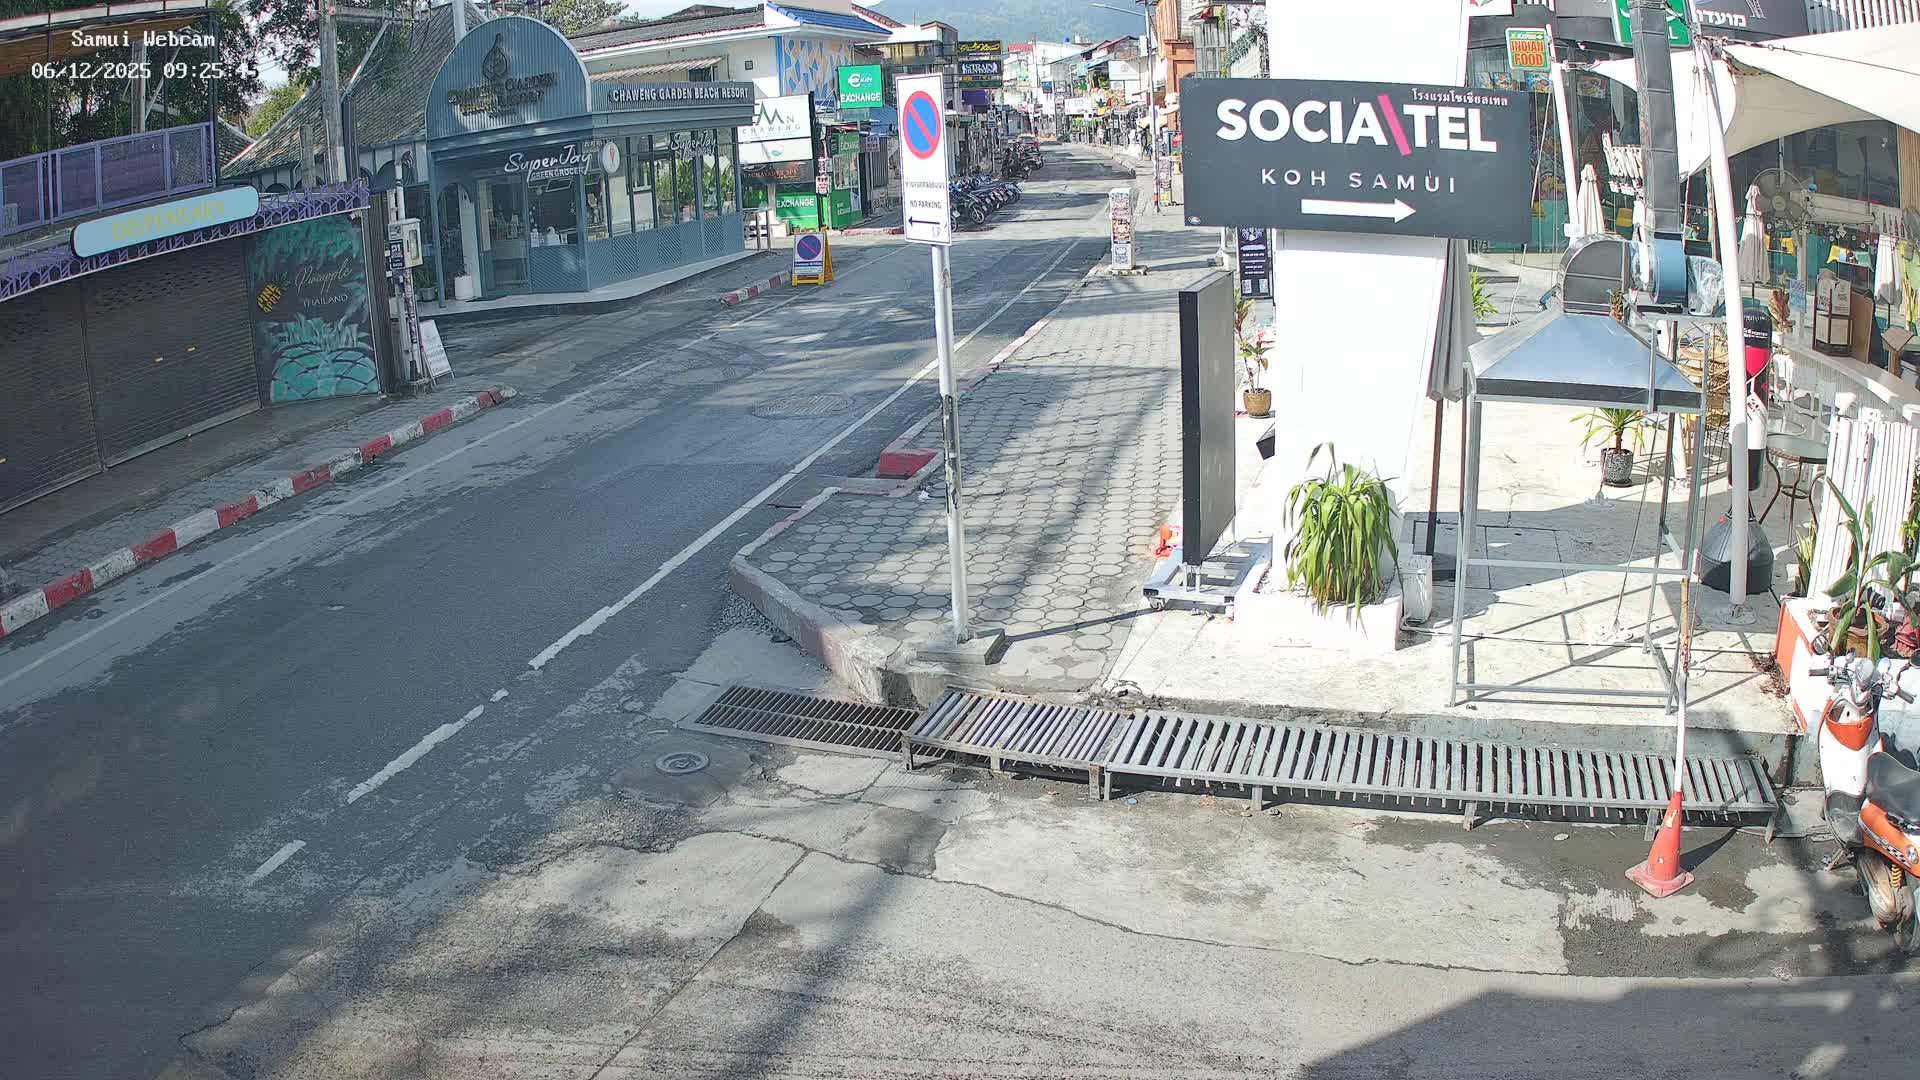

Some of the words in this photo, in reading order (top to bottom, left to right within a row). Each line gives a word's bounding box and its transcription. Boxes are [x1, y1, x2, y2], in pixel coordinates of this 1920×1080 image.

[1695, 10, 1746, 27] מועדו
[1511, 40, 1544, 52] INDIAN
[1514, 53, 1544, 66] FOOD
[613, 89, 656, 102] CHAWENG
[660, 88, 692, 100] GARDEN
[695, 87, 719, 99] BEACH
[721, 88, 748, 99] RESORT
[840, 92, 881, 103] EXCHANGE
[1261, 168, 1326, 186] KOH
[1349, 172, 1455, 193] SAMUI
[776, 198, 814, 208] EXCHANGE
[910, 200, 918, 208] NO
[919, 200, 942, 209] PARKING
[112, 199, 225, 242] DISPENSARY
[303, 294, 348, 308] THAILAND
